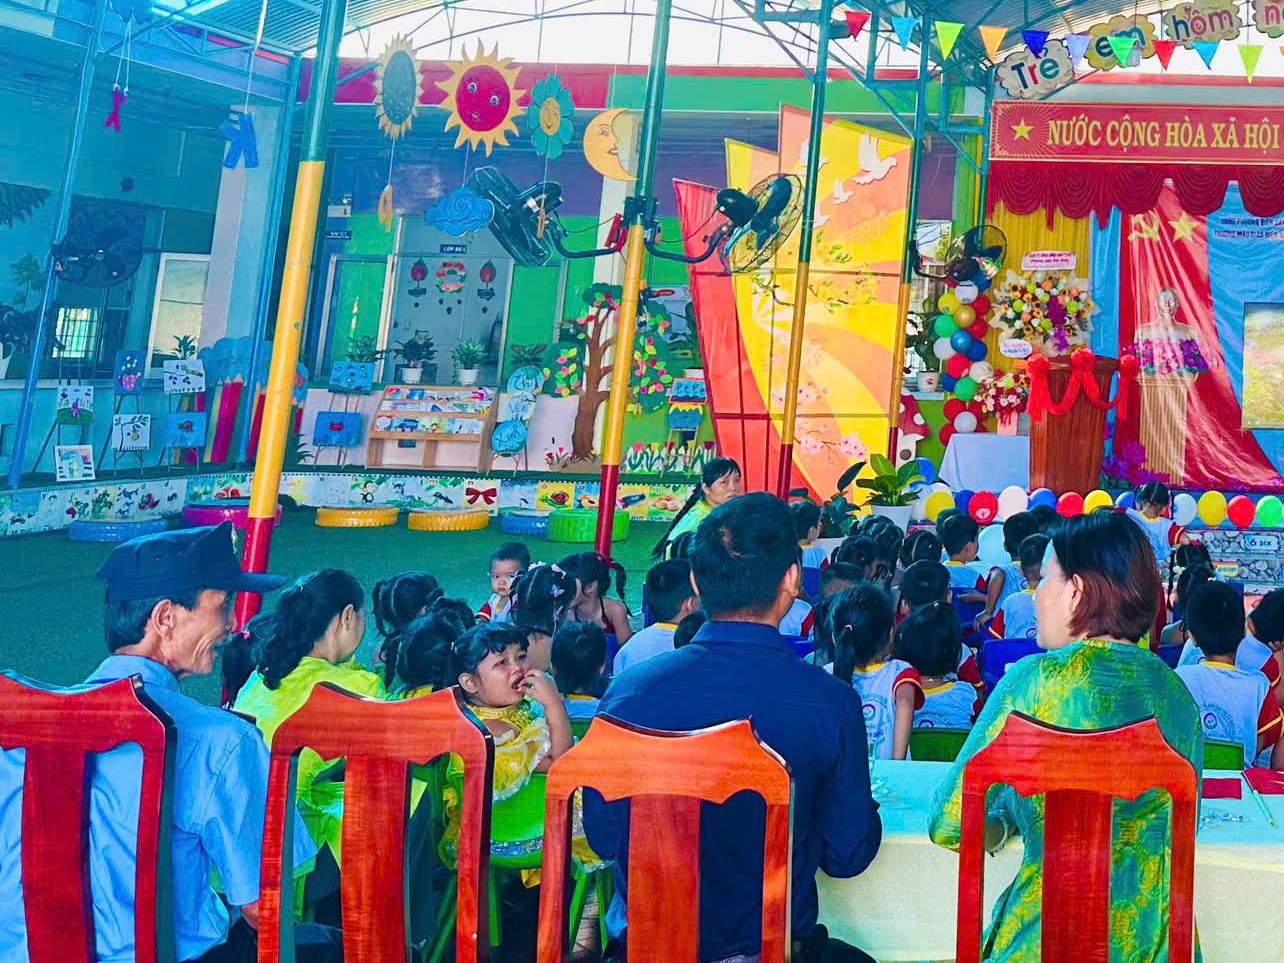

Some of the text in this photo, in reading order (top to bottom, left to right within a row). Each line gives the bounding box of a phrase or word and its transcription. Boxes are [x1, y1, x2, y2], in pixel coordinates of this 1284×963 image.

[1011, 48, 1060, 89] Trẻ
[1172, 8, 1234, 40] hôm
[1047, 113, 1102, 146] NƯỚC
[1106, 114, 1161, 152] CỘNG
[1165, 115, 1208, 148] HÒA
[1210, 117, 1239, 149] XÃ
[1243, 117, 1280, 154] HỘI
[1250, 537, 1272, 547] 6 six
